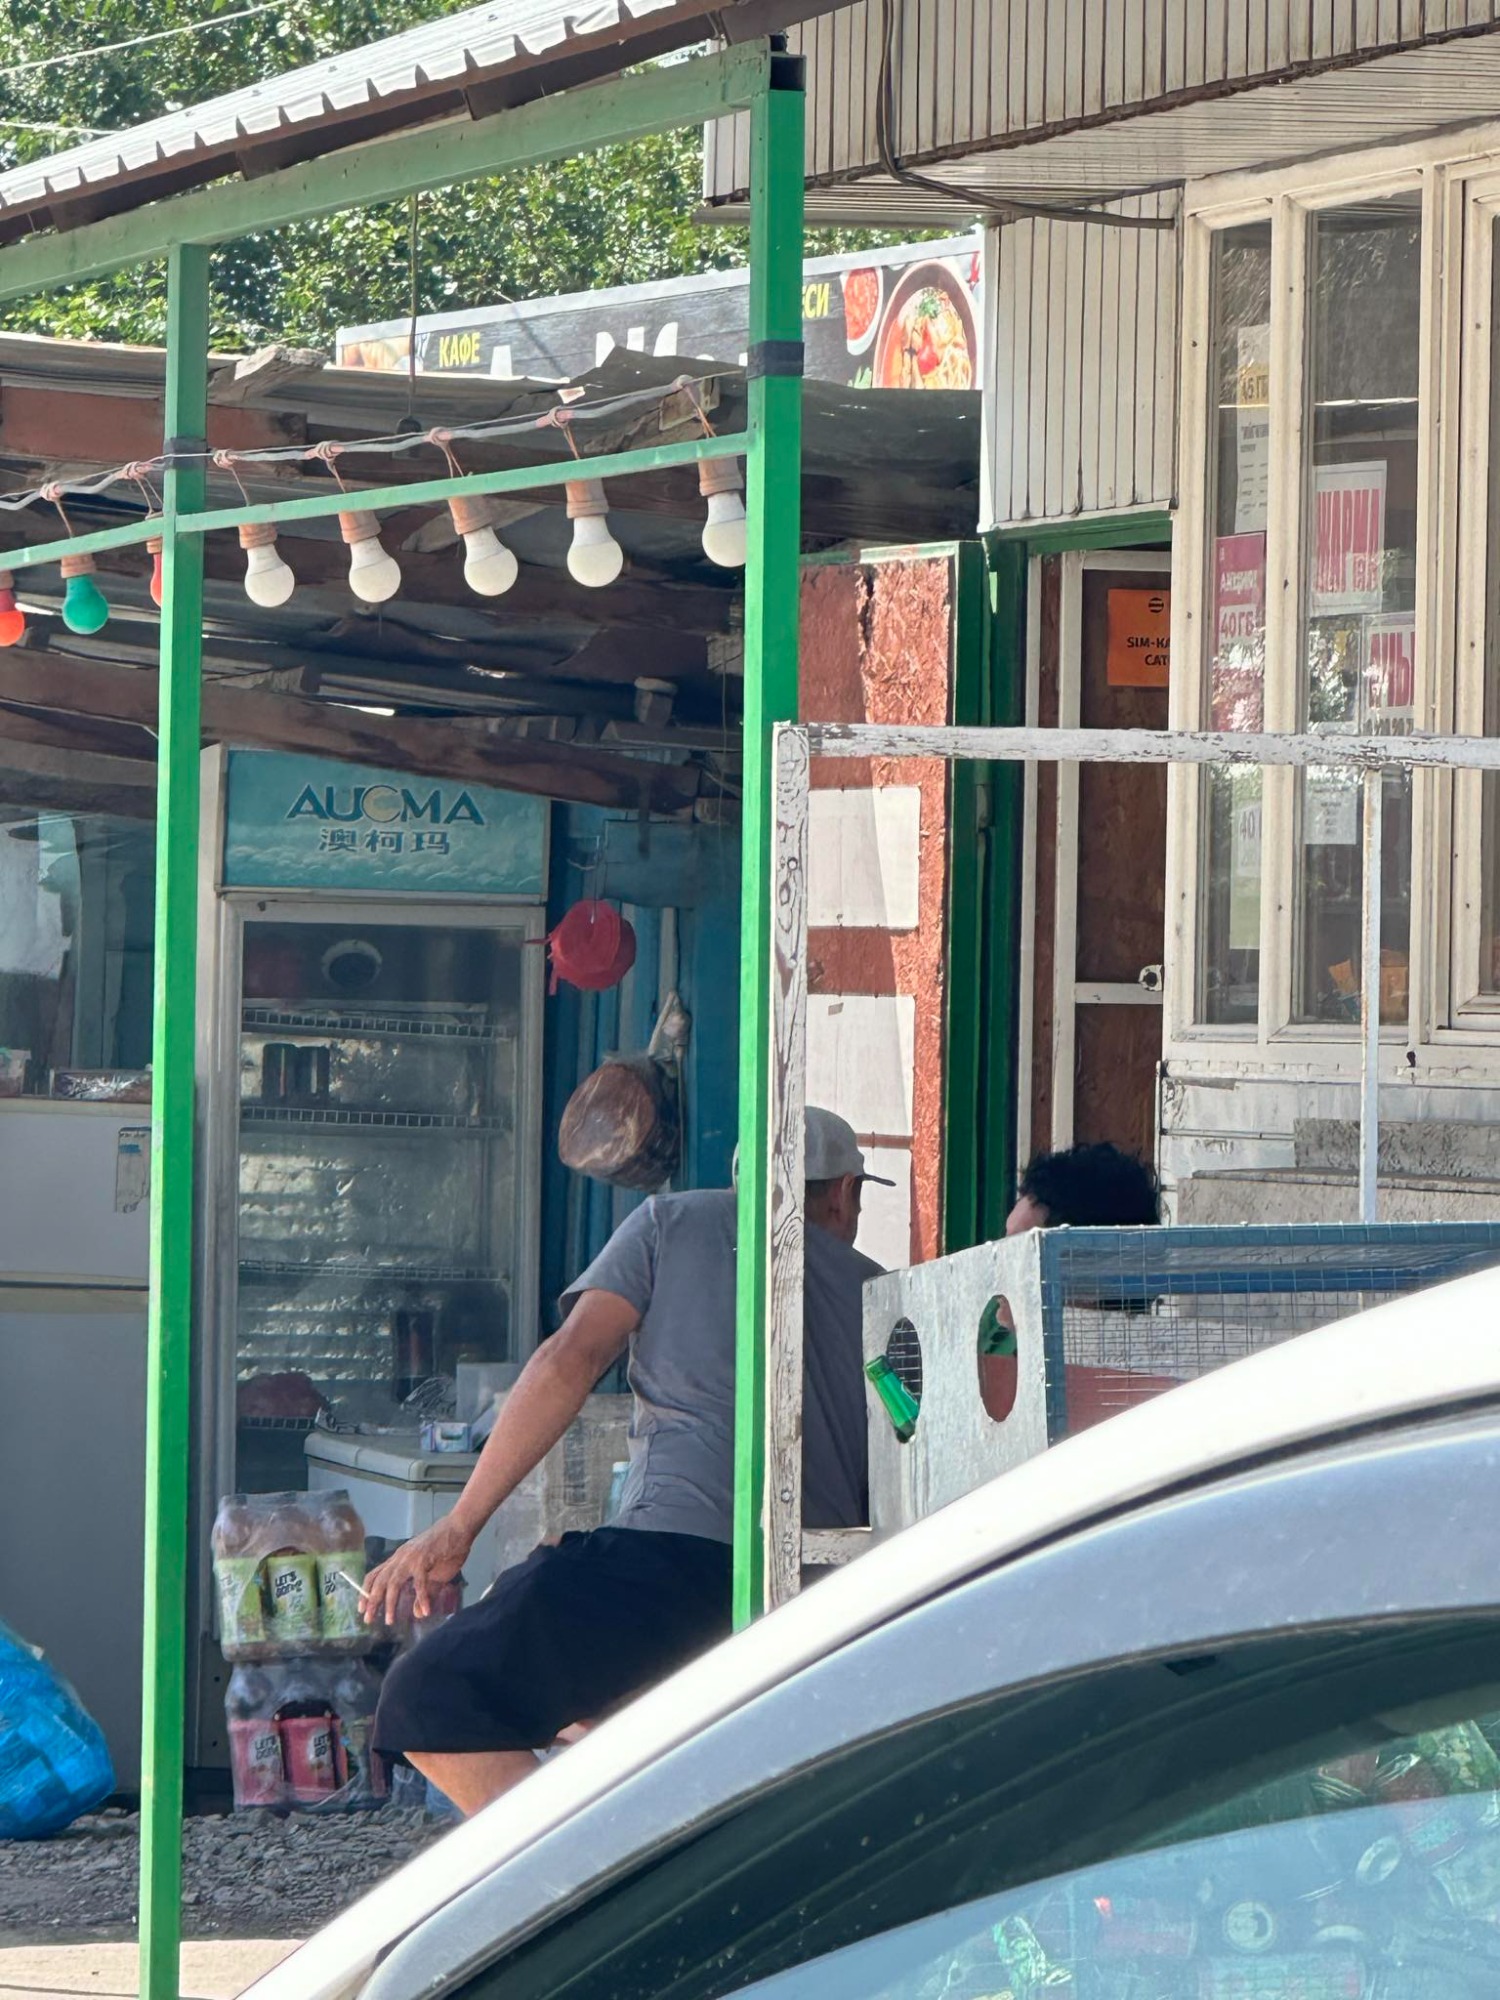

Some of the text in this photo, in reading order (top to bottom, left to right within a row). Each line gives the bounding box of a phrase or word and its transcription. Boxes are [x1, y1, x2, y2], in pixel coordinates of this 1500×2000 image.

[802, 282, 830, 319] СИ
[439, 331, 481, 368] КАФЕ
[1144, 654, 1170, 666] САТ
[285, 783, 486, 826] AUCMA
[318, 828, 451, 856] 澳柯玛
